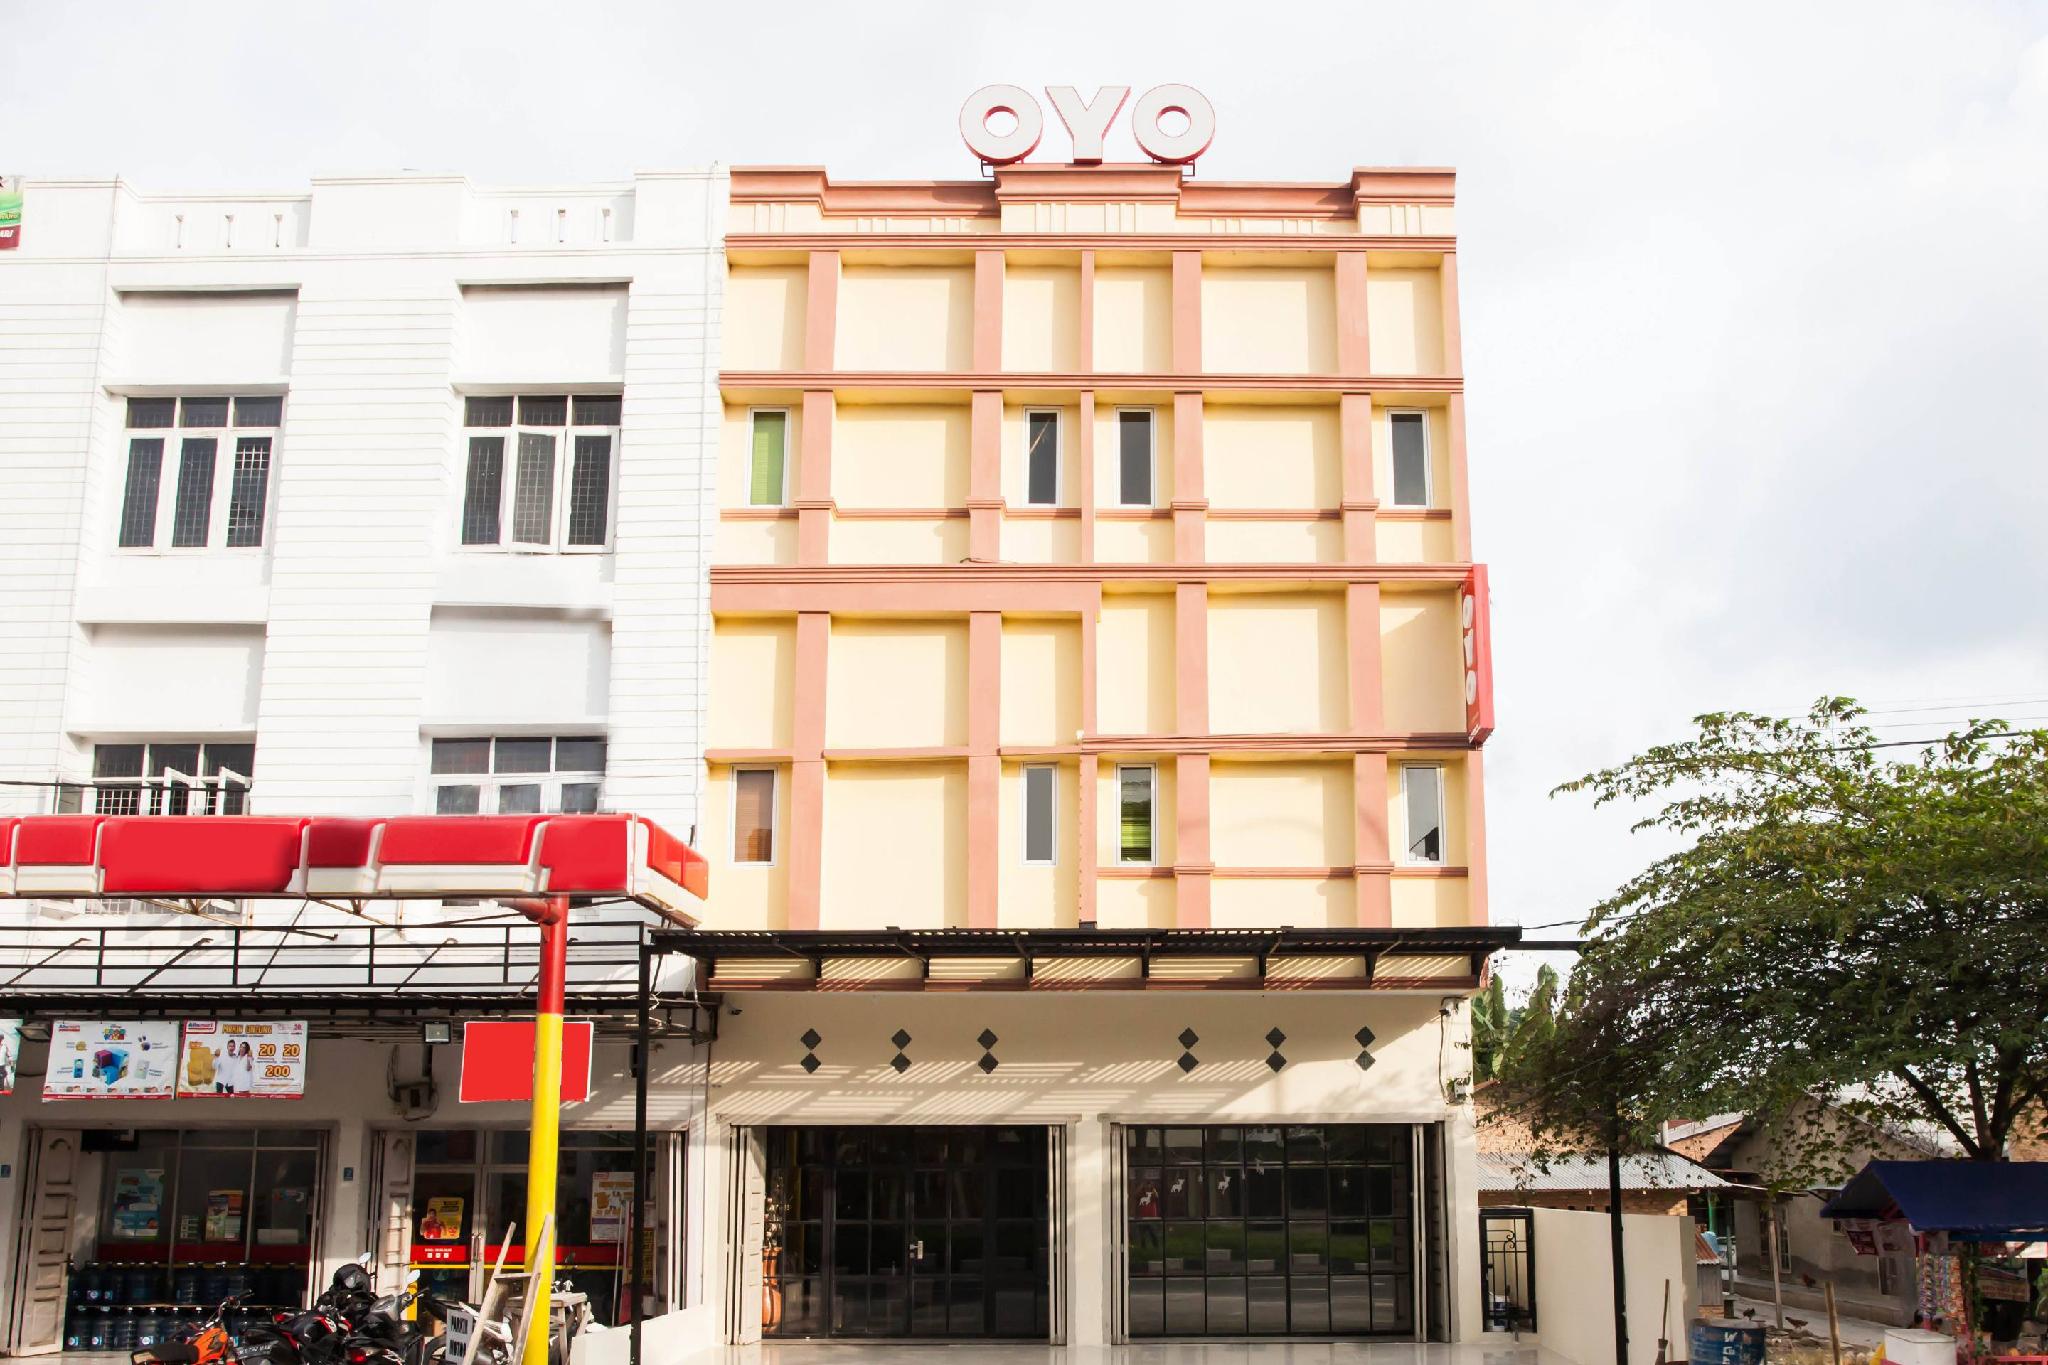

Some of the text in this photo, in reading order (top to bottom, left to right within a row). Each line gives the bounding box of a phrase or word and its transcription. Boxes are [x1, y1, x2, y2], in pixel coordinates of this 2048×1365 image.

[959, 83, 1216, 164] OYO
[1463, 594, 1476, 705] OYO
[258, 1043, 276, 1056] 20
[282, 1043, 300, 1056] 20
[265, 1065, 290, 1077] 200
